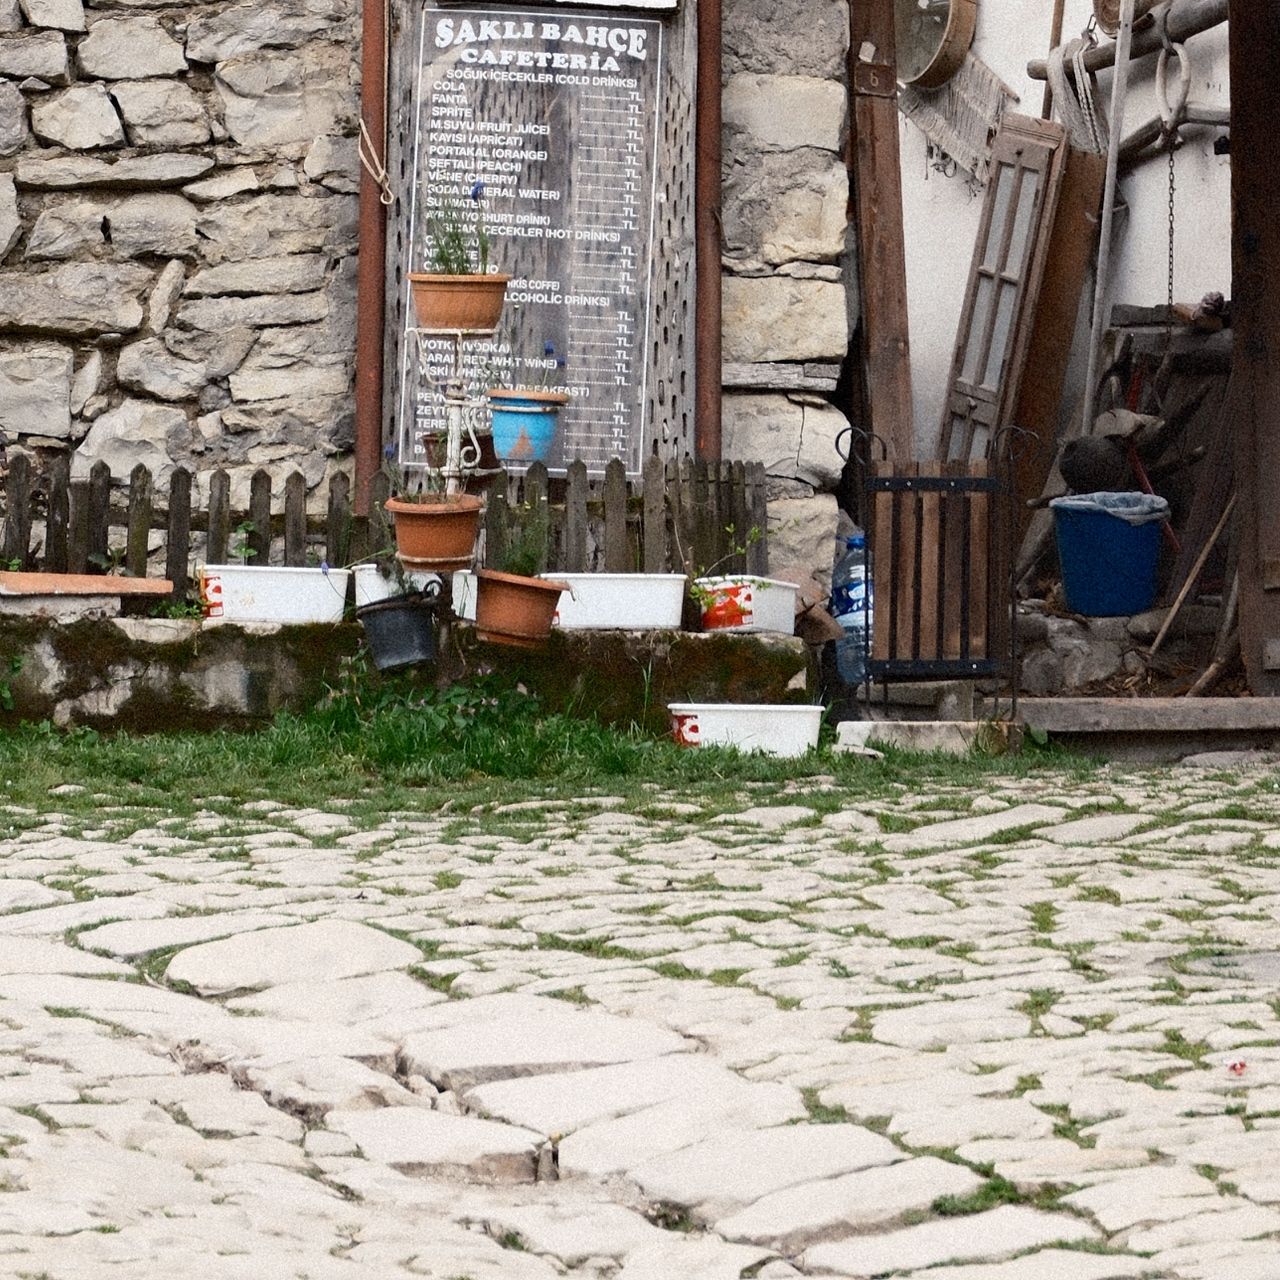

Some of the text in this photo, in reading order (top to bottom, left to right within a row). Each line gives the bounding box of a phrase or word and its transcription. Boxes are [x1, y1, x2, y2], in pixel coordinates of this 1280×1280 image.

[435, 18, 648, 60] SAKLI BAHÇE
[460, 48, 621, 71] CAFETERİA
[446, 68, 488, 80] SOĞUK
[490, 69, 553, 84] İÇECEKLER
[556, 74, 590, 85] (COLD
[433, 80, 466, 91] COLA
[432, 93, 468, 104] FANTA
[431, 106, 474, 118] SPRİTE
[430, 119, 475, 130] M.SUYU
[430, 132, 466, 143] KAYISI
[430, 145, 490, 157] PORTAKAL
[492, 148, 548, 160] (ORANGE)
[478, 160, 522, 172] (PEACH)
[465, 173, 518, 185] (CHERRY)
[519, 188, 560, 200] WATER)
[427, 197, 442, 207] SU
[481, 225, 543, 237] ÇECEKLER
[546, 228, 572, 239] (HOT
[463, 341, 511, 353] (VODKA)
